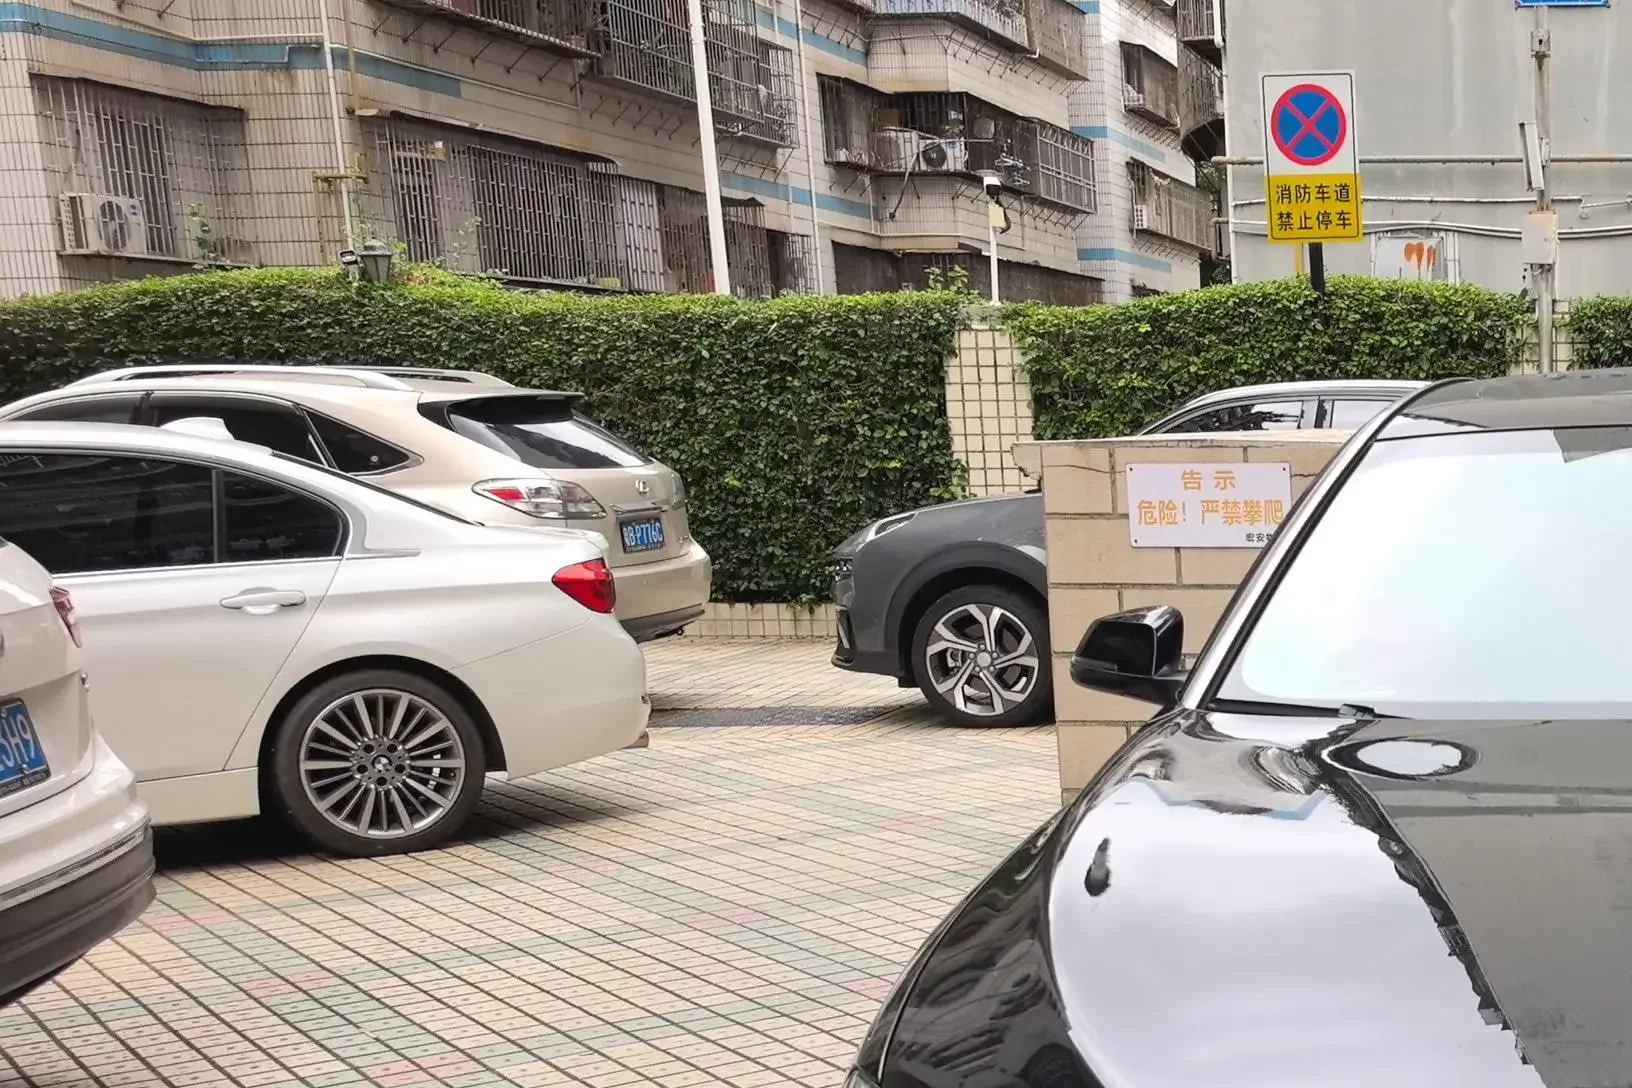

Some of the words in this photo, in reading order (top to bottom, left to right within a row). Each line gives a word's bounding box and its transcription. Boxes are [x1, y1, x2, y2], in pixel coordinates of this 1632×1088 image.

[1276, 183, 1351, 204] 消防车道
[1277, 210, 1353, 231] 禁止停车
[1181, 470, 1236, 491] 告示
